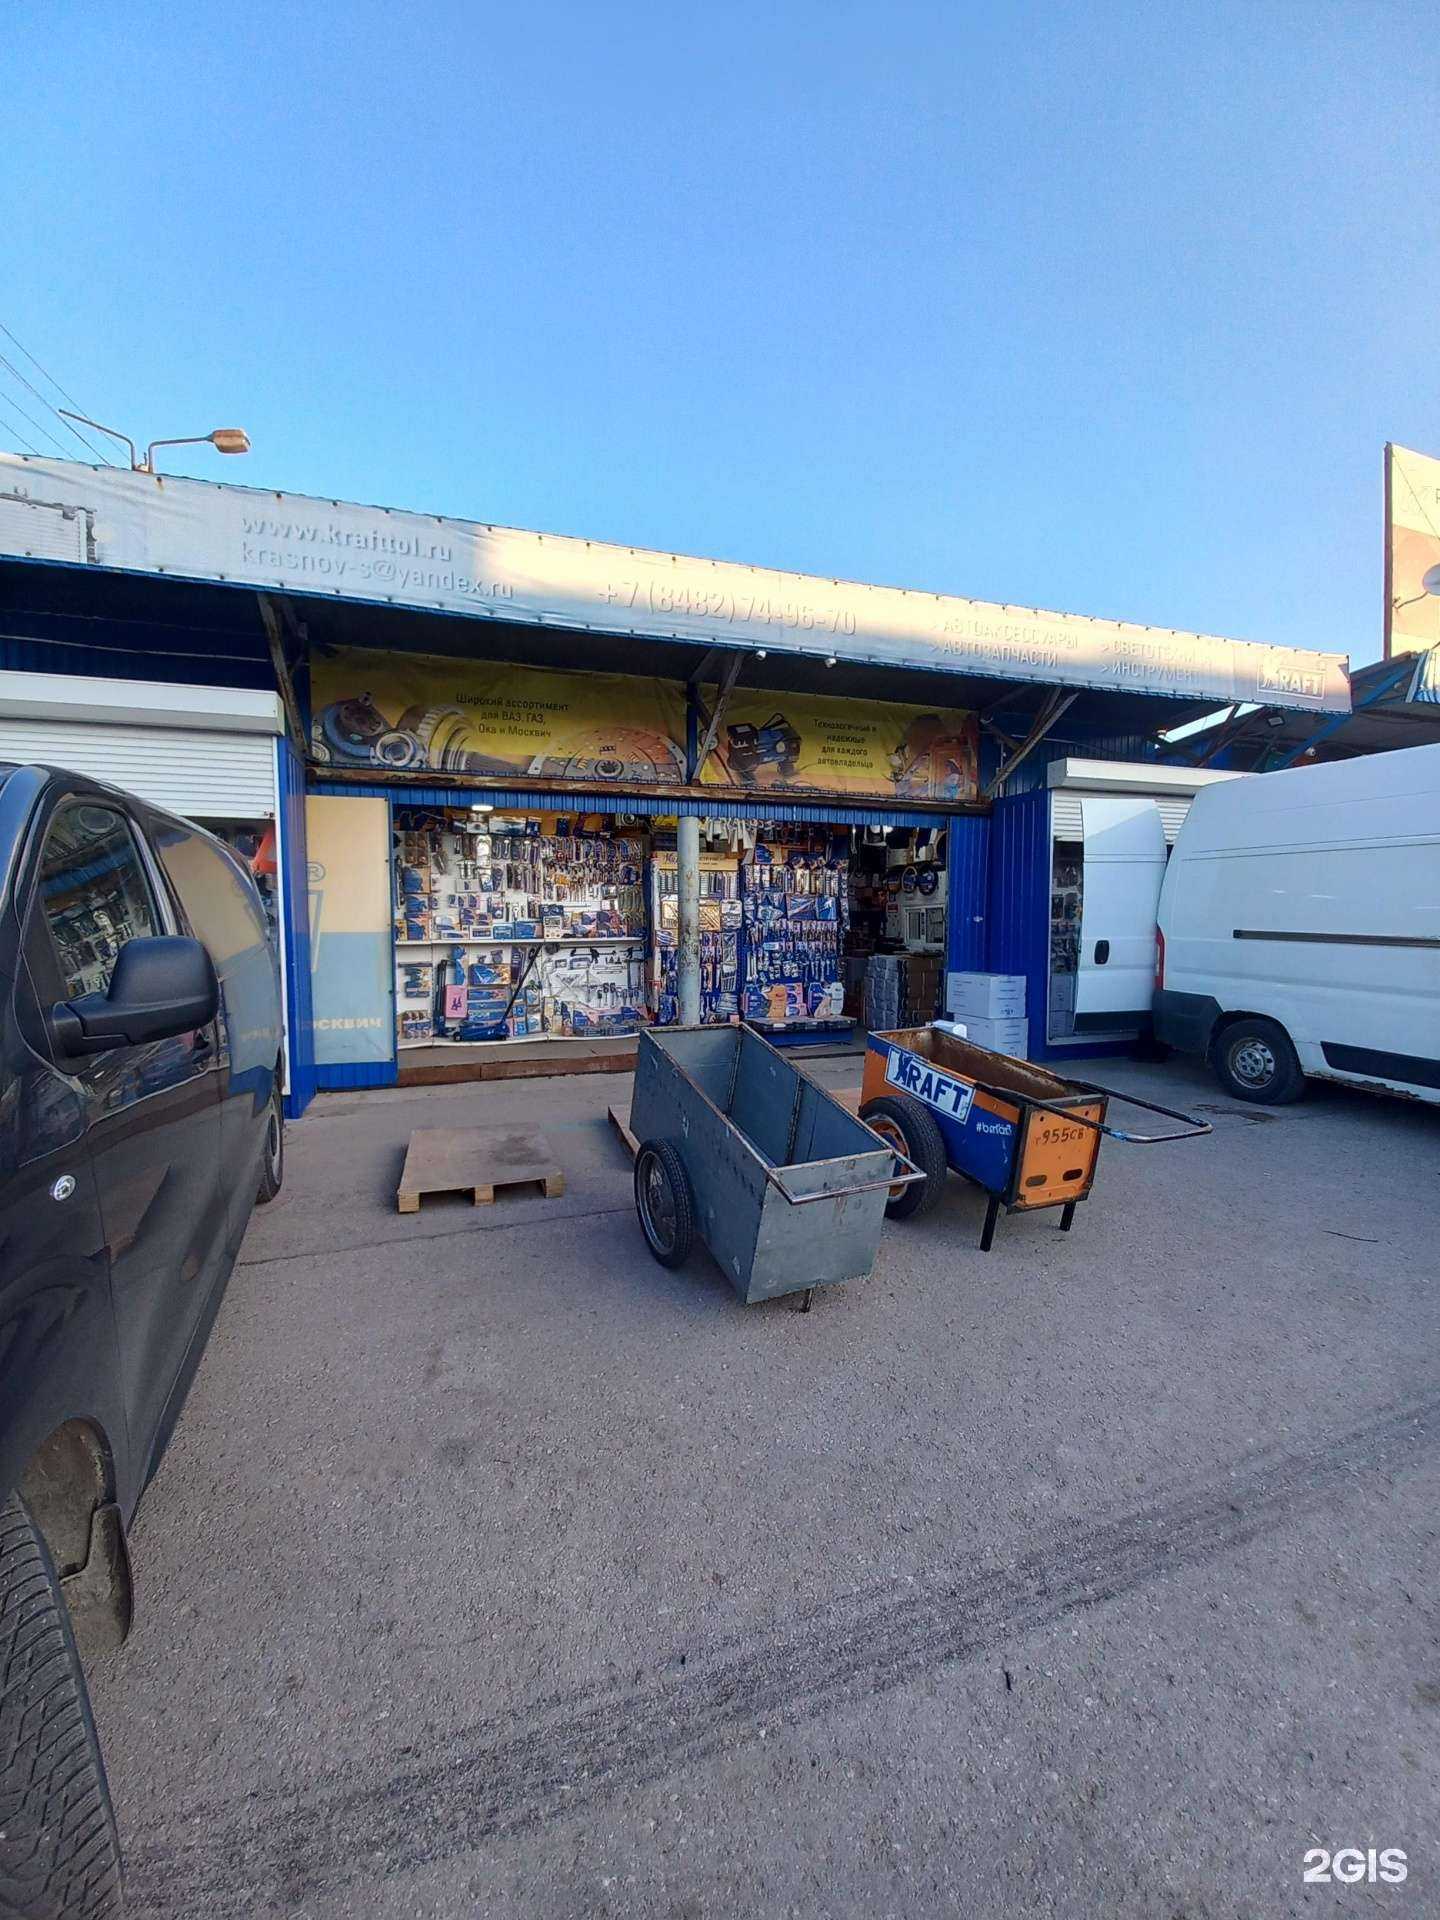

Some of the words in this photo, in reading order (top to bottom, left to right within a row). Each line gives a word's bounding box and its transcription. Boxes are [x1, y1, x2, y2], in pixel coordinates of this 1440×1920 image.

[241, 542, 515, 600] krasnov-s@yandex.ru
[943, 639, 1058, 667] АВТОЗАПЧАСТИ
[1113, 640, 1213, 671] СВЕТОТЕХНИ
[456, 692, 503, 706] Широкий
[505, 700, 569, 713] ассортимент
[480, 711, 499, 721] для
[478, 723, 497, 734] Ока
[508, 725, 551, 738] Москвич
